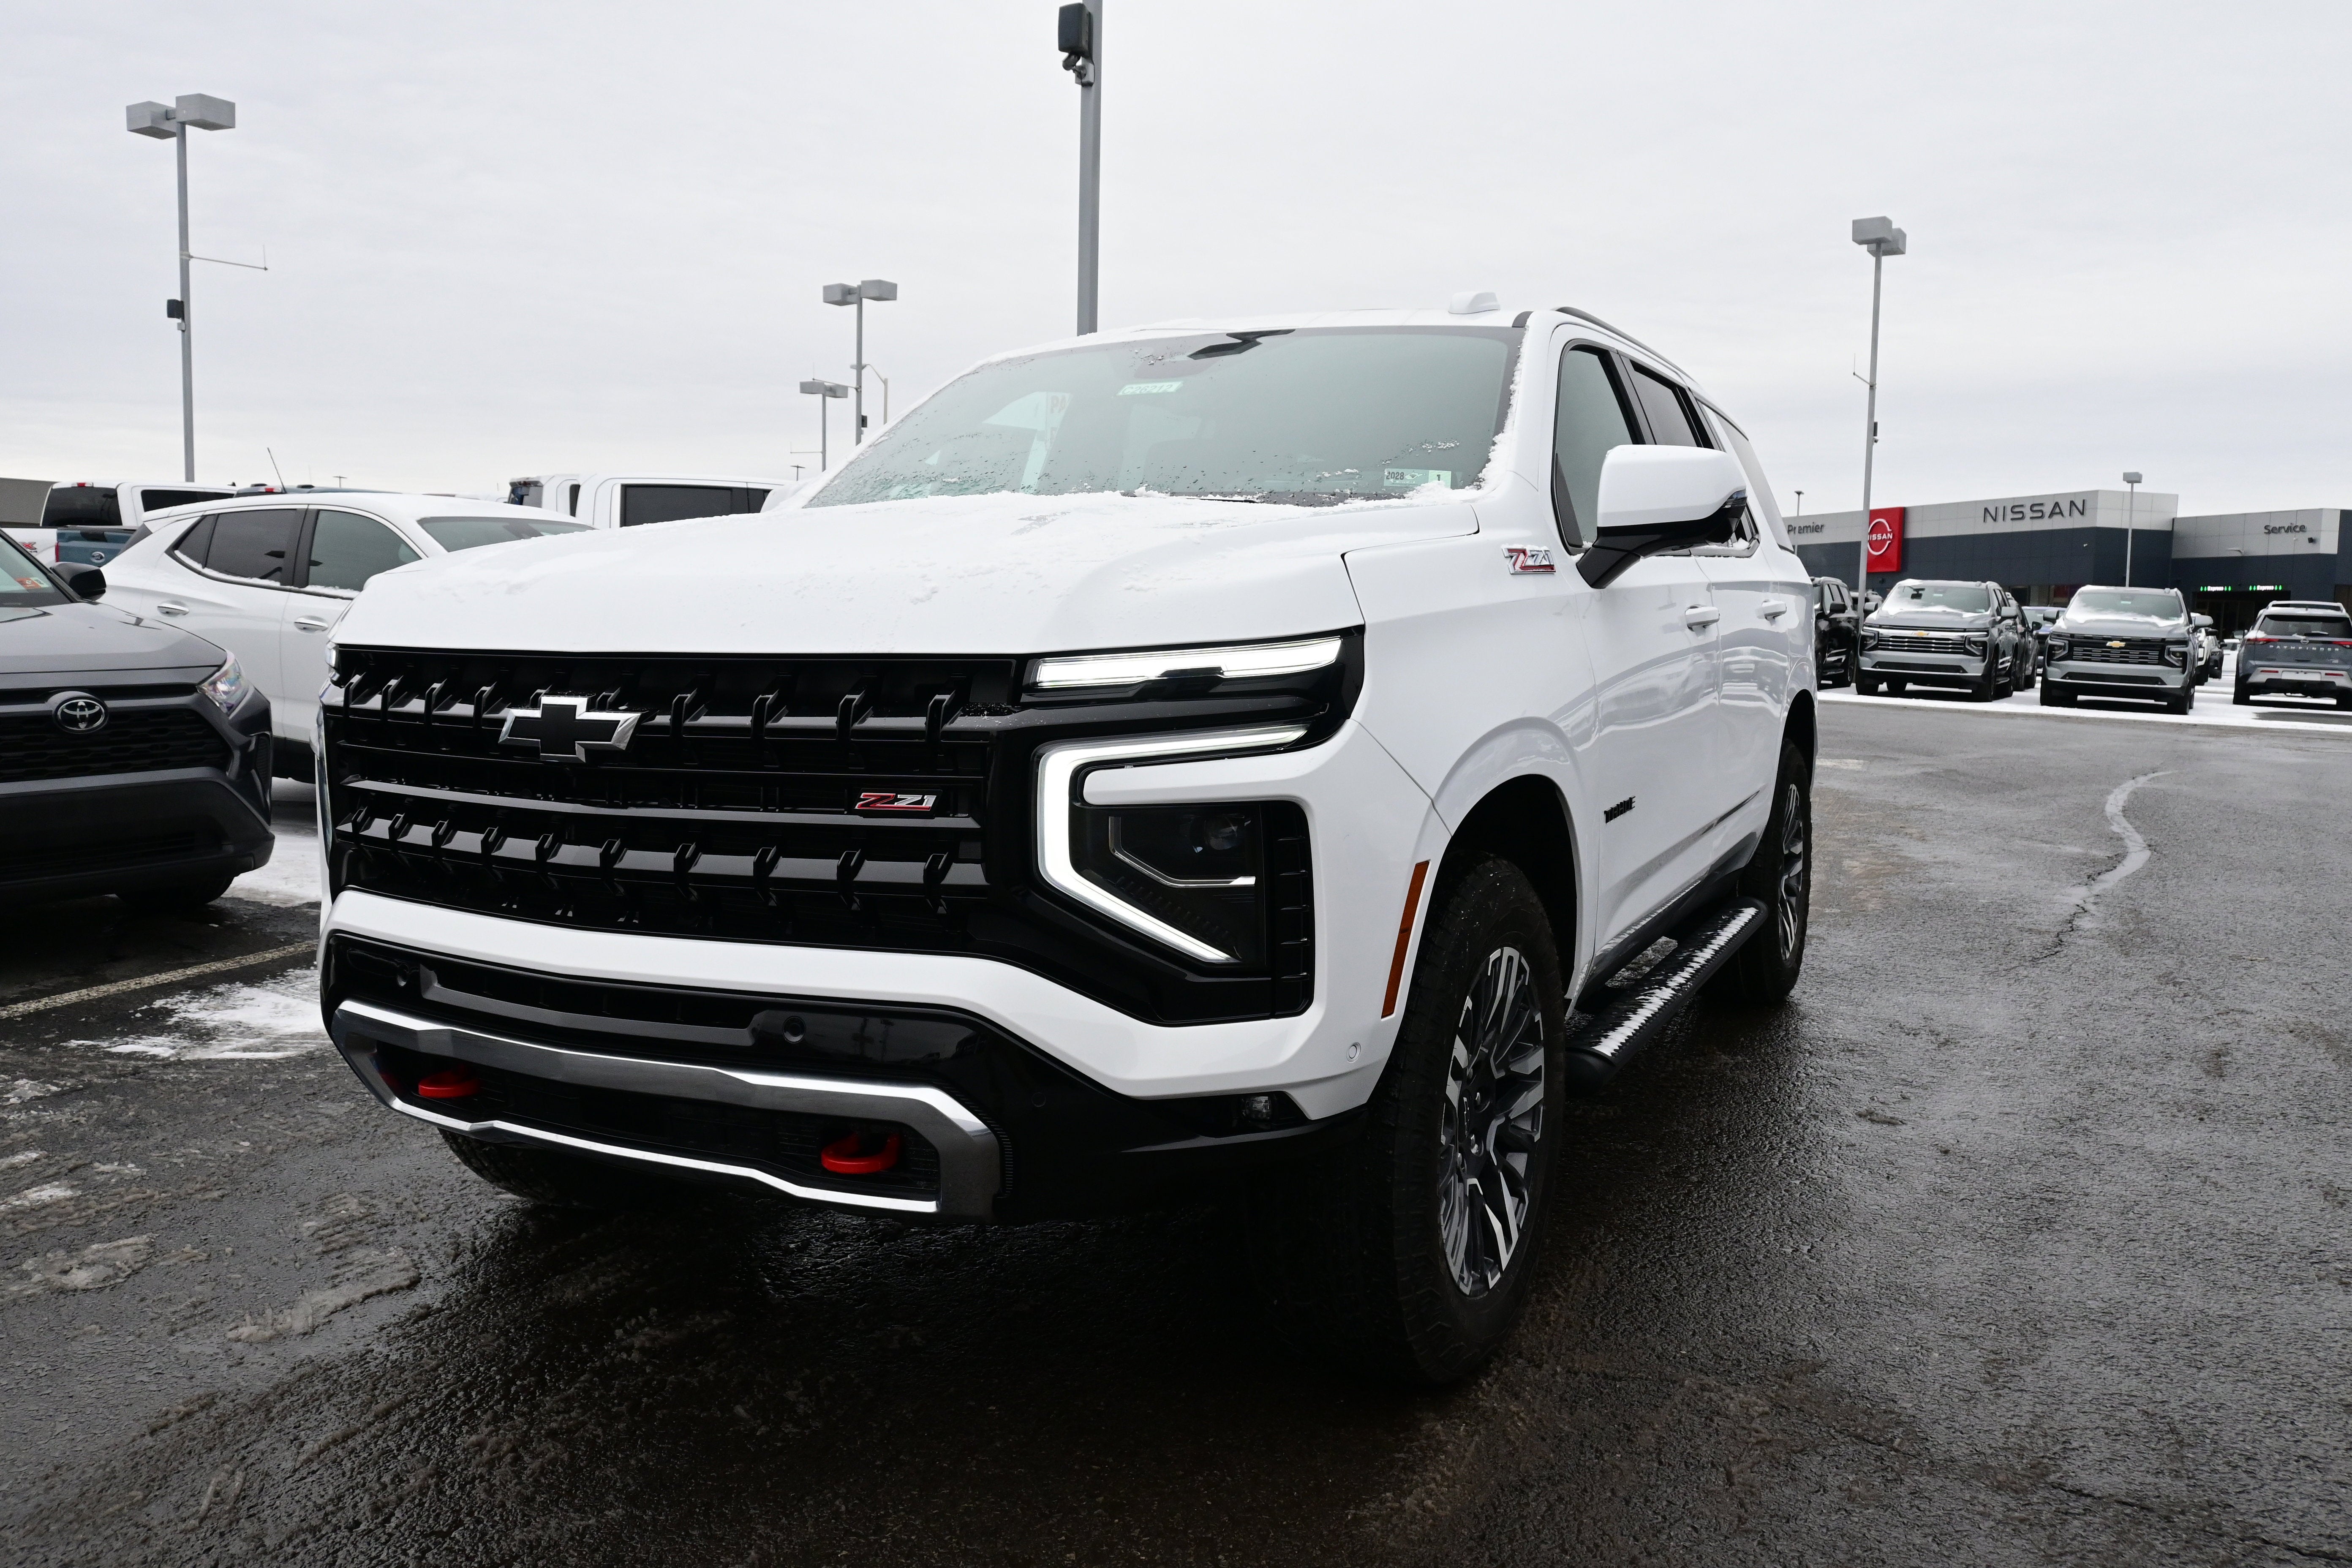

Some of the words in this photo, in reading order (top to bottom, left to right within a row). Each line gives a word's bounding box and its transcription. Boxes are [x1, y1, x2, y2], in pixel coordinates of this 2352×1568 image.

[1122, 384, 1173, 394] C26212
[1386, 471, 1405, 481] 2028
[1983, 499, 2086, 523] NISSAN
[1787, 522, 1824, 534] Premier
[2264, 522, 2306, 534] Service
[1867, 533, 1893, 541] ISSAN
[1501, 547, 1557, 574] Z71
[855, 792, 937, 811] Z71
